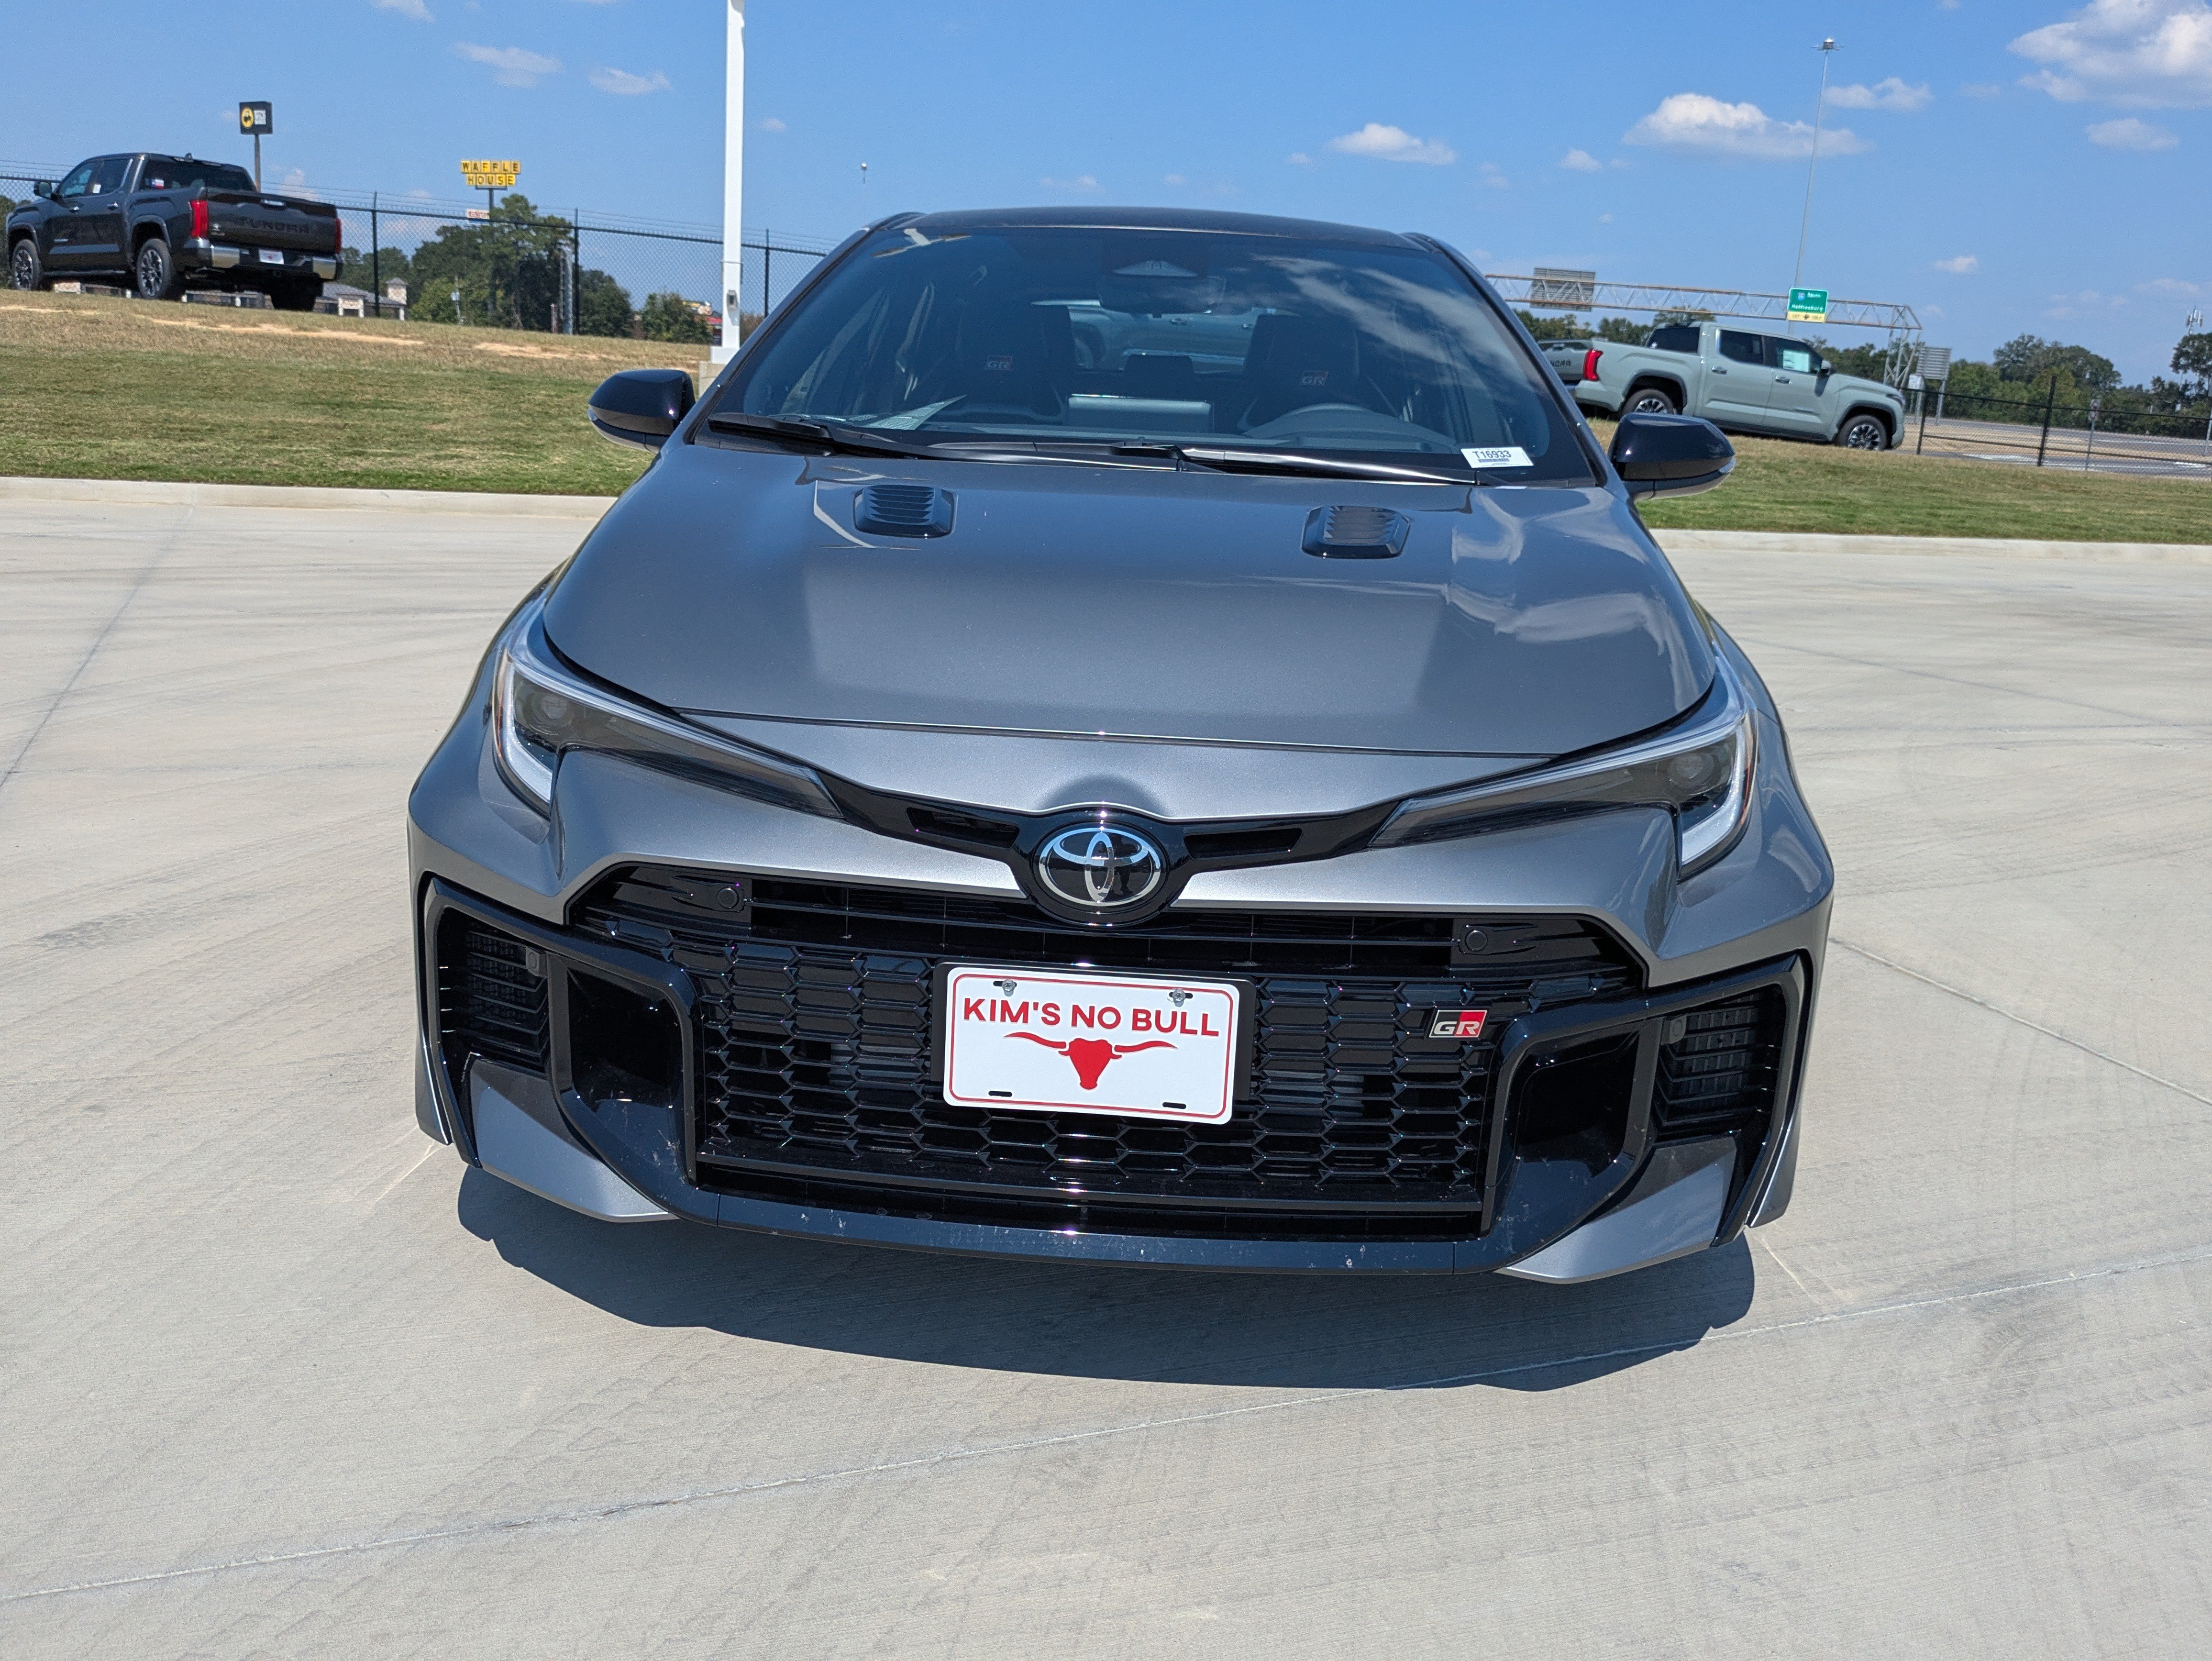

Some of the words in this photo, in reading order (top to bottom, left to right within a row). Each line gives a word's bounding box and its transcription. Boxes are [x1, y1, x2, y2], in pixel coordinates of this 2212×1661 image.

[462, 162, 519, 172] WAFFLE
[467, 175, 514, 185] HOUSE
[1550, 359, 1571, 367] NDRA
[1472, 450, 1512, 459] T16933
[963, 998, 1061, 1026] KIM'S
[1071, 1005, 1121, 1030] NO
[1132, 1008, 1219, 1037] BULL
[1434, 1021, 1480, 1034] GR
